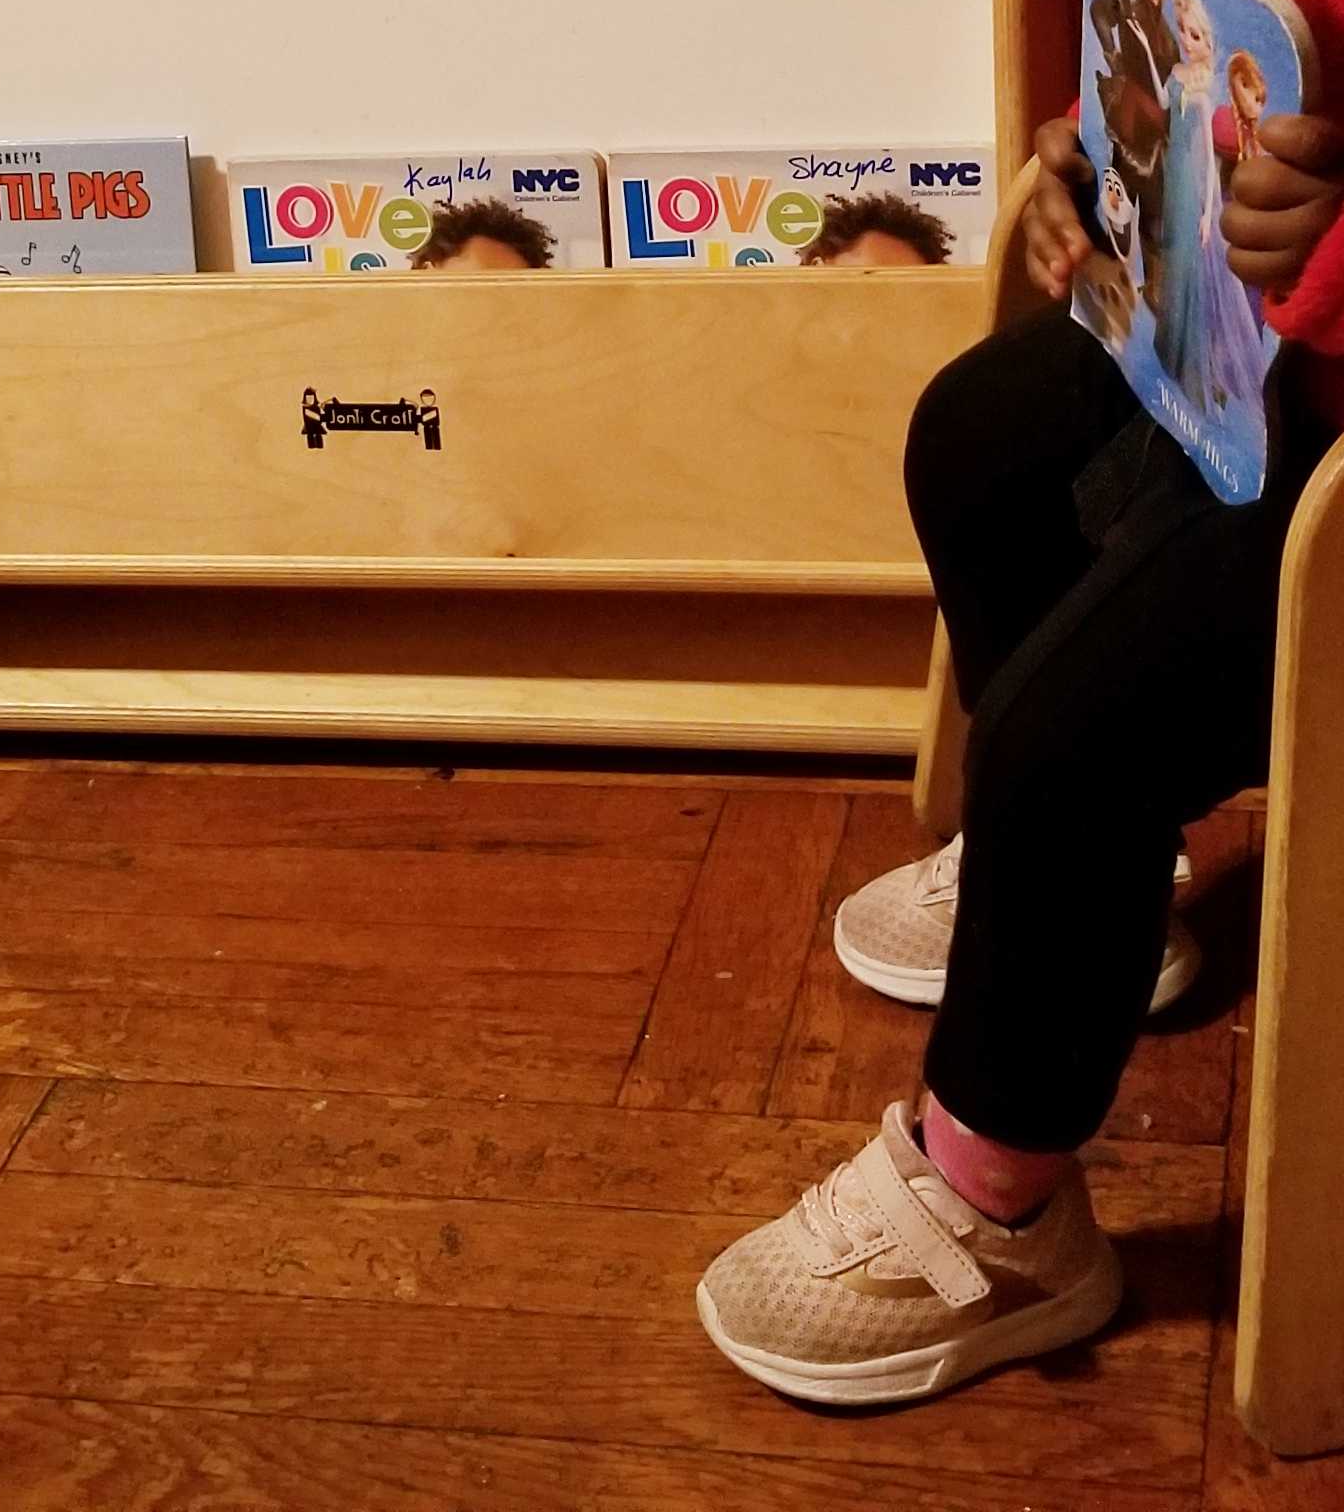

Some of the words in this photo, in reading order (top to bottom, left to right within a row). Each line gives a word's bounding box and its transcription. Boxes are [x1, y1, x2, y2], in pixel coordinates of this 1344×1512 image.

[404, 157, 491, 202] Kaylah
[512, 168, 580, 193] NYC
[788, 154, 896, 190] Shayne
[910, 162, 981, 187] NYC
[68, 170, 151, 219] PIGS
